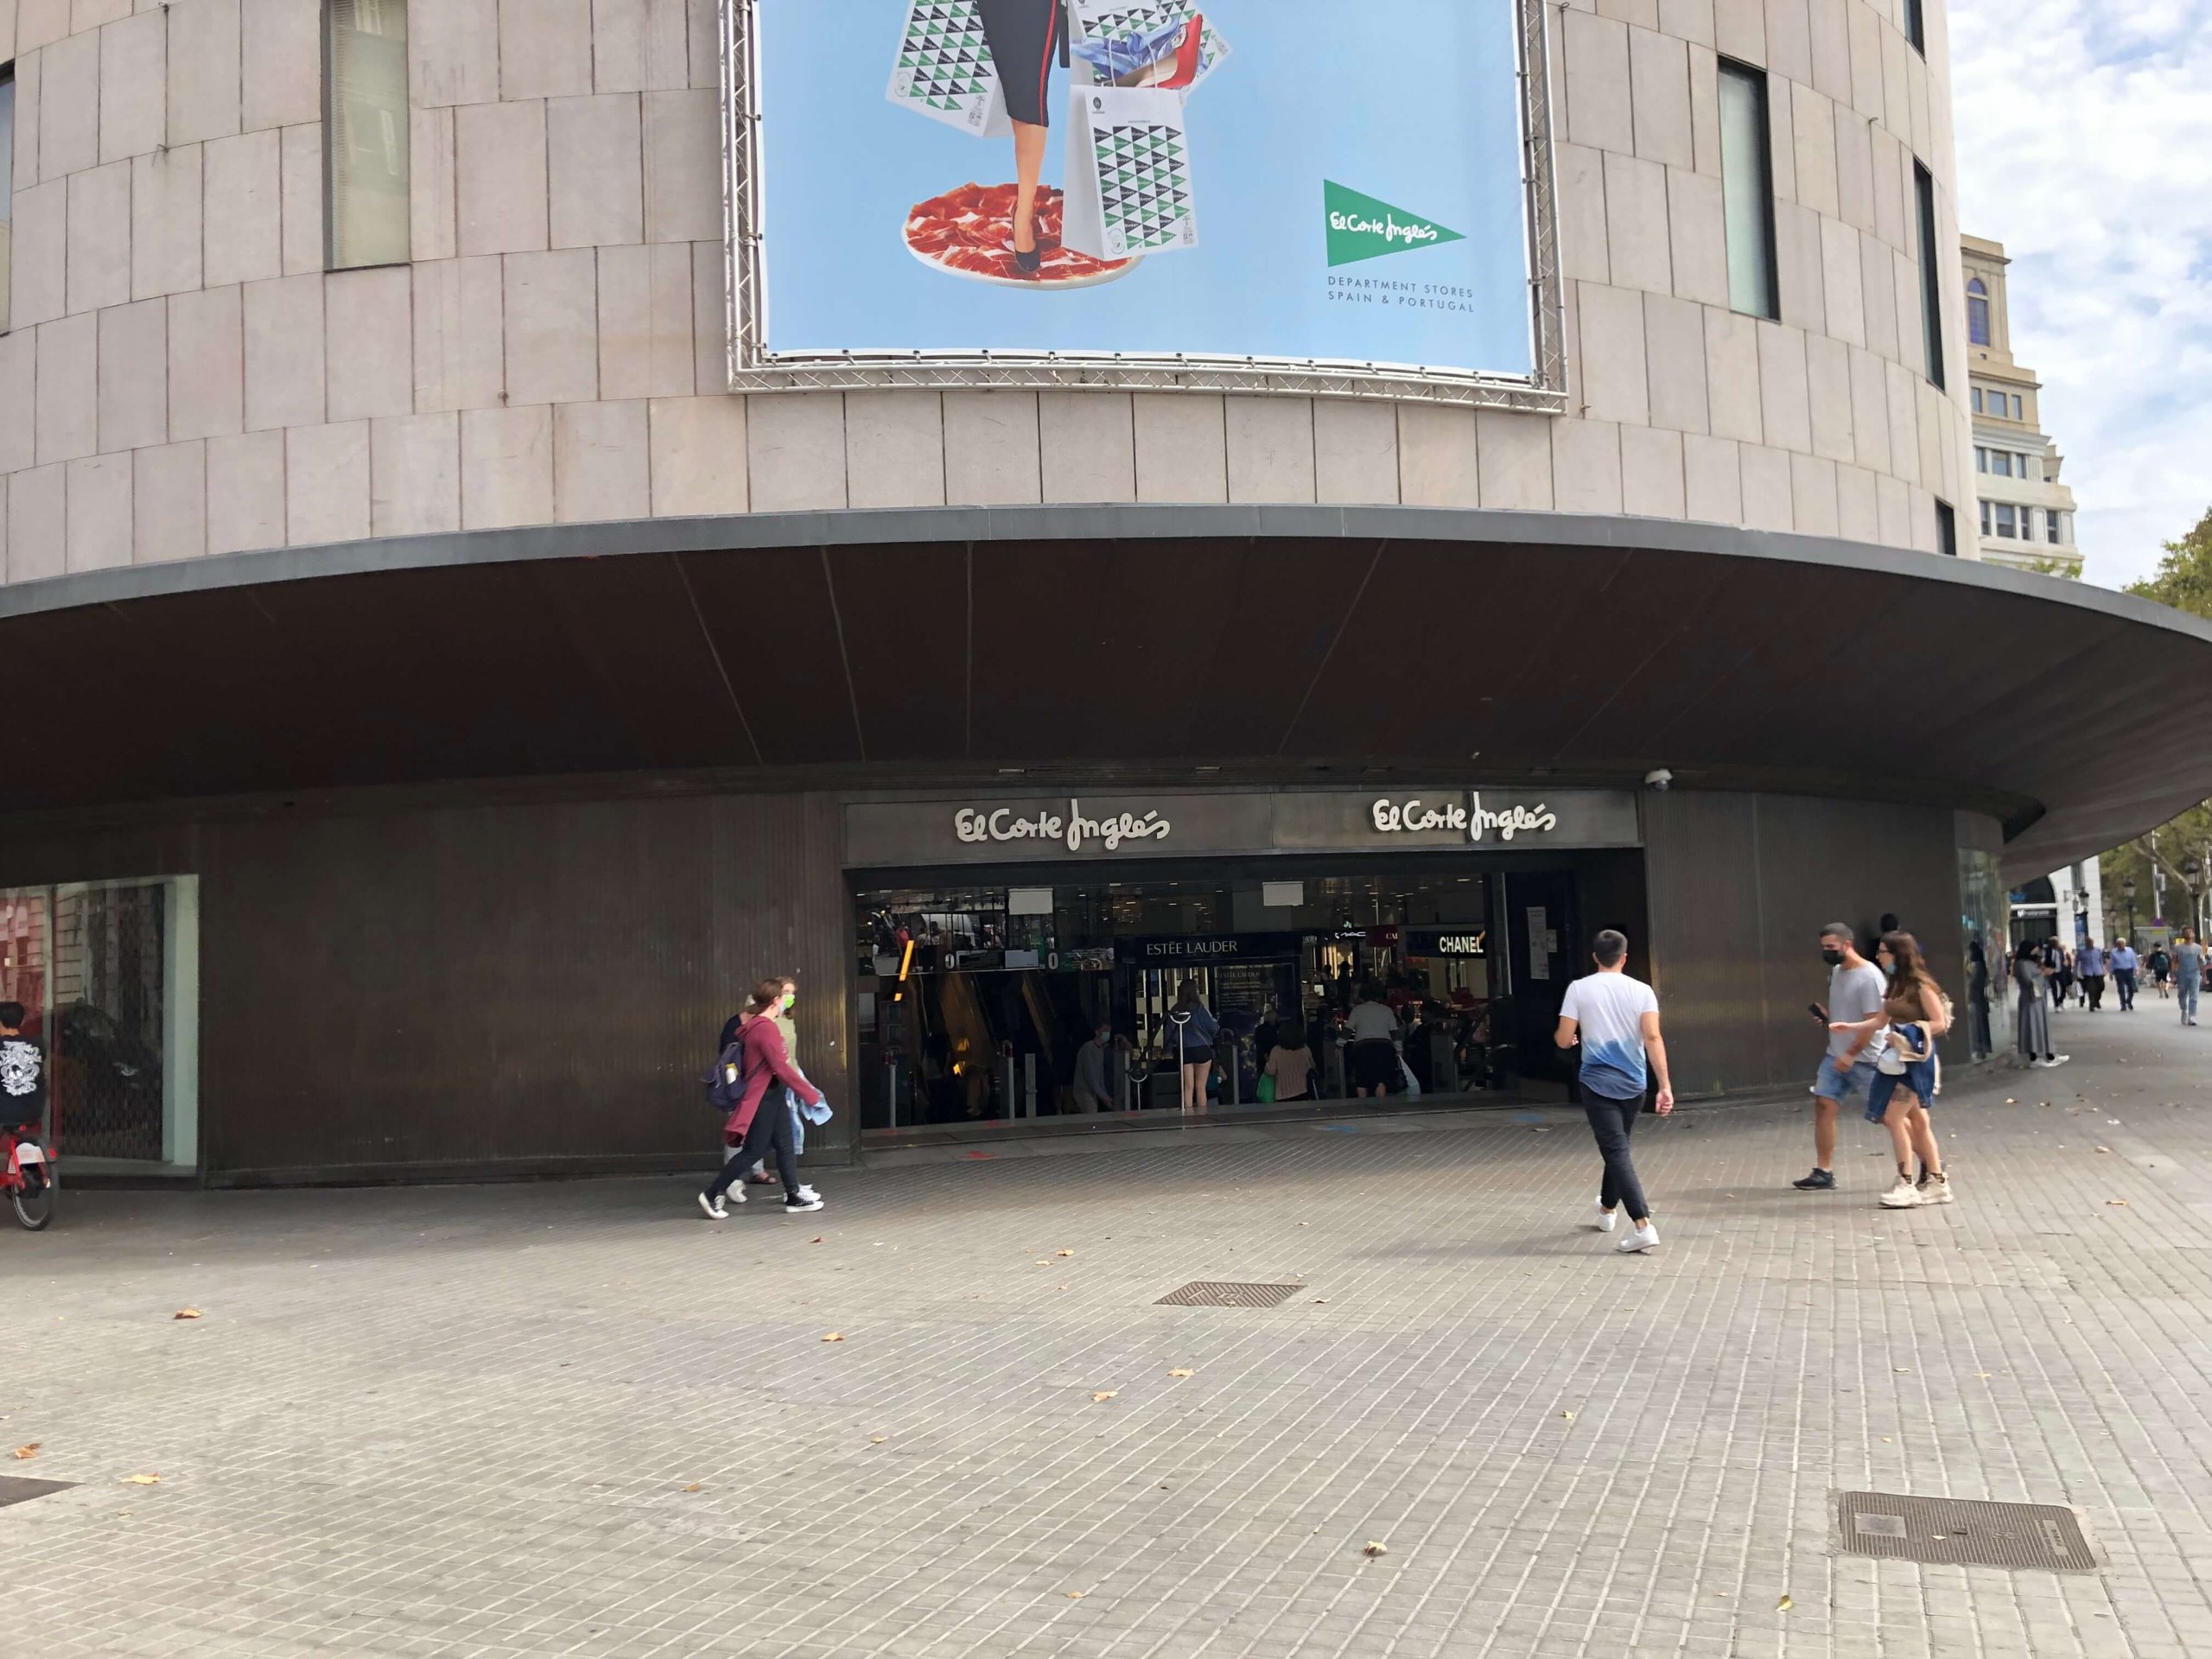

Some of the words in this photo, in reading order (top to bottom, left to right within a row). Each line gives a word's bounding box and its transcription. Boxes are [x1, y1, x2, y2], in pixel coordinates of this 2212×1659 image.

[1329, 211, 1347, 230] El
[1346, 214, 1384, 236] Corte
[1385, 213, 1438, 244] Inglés
[1327, 276, 1418, 293] DEPARTMENT
[1424, 283, 1474, 299] STORES
[1327, 290, 1373, 303] SPAIN
[1381, 294, 1390, 305] &
[1398, 296, 1475, 314] PORTUGAL
[954, 808, 988, 842] El
[988, 808, 1063, 842] Corte
[1066, 798, 1171, 851] Inglés
[1372, 798, 1402, 832] El
[1402, 798, 1467, 832] Corte
[1470, 791, 1556, 842] Inglés
[1186, 940, 1237, 954] LAUDER
[1439, 936, 1484, 954] CHANEL
